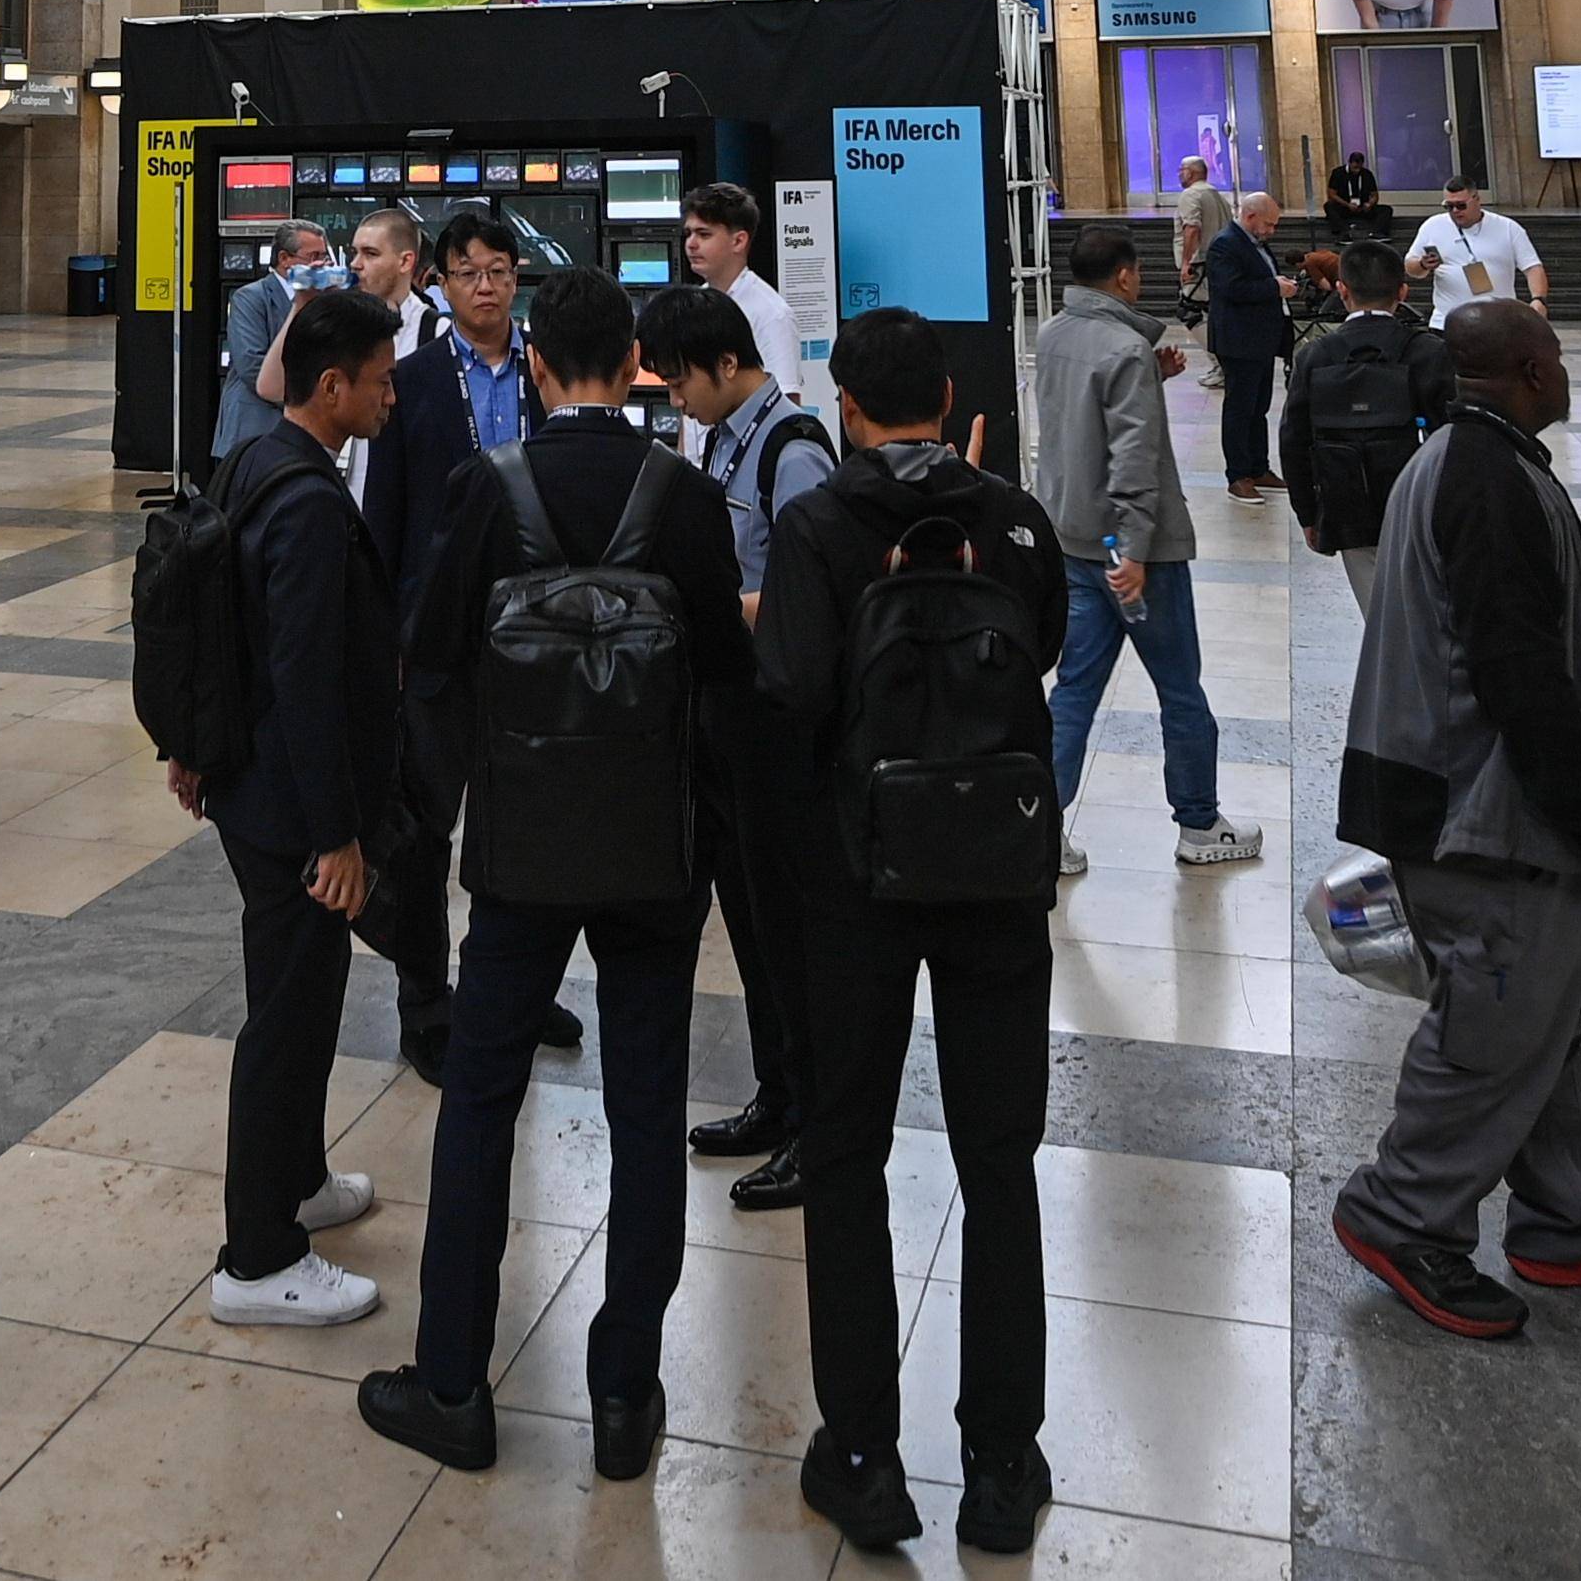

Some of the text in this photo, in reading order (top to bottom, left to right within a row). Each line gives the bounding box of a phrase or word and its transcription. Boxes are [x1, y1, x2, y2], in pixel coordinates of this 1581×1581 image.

[1112, 11, 1197, 27] SAMSUNG
[844, 118, 961, 142] IFA Merch
[147, 131, 175, 151] IFA
[147, 157, 194, 180] Shop
[845, 147, 905, 176] Shop
[783, 190, 803, 205] IFA
[784, 224, 810, 234] Future
[784, 237, 815, 249] Signals
